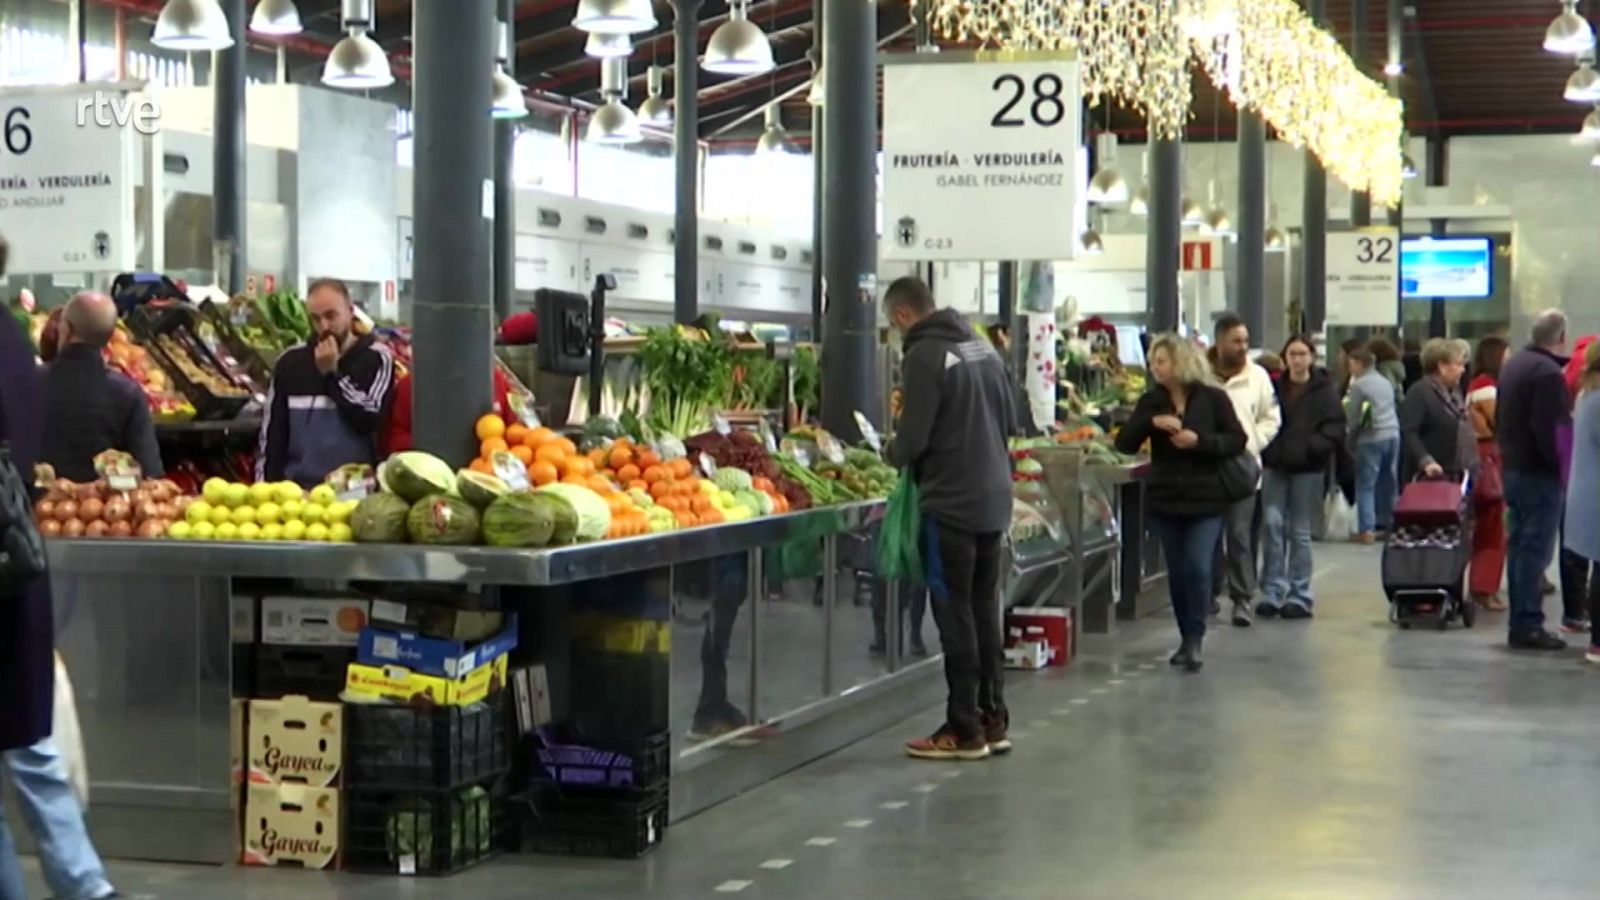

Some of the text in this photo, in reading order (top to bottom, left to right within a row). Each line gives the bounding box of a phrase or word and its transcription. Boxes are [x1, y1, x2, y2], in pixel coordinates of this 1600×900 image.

[990, 72, 1065, 127] 28
[0, 106, 32, 156] 6
[893, 149, 1064, 169] FRUTERÍA VERDULERÍA
[38, 170, 112, 190] VERDULERÍA
[936, 171, 1064, 188] ISABEL FERNÁNDEZ
[1356, 236, 1393, 264] 32
